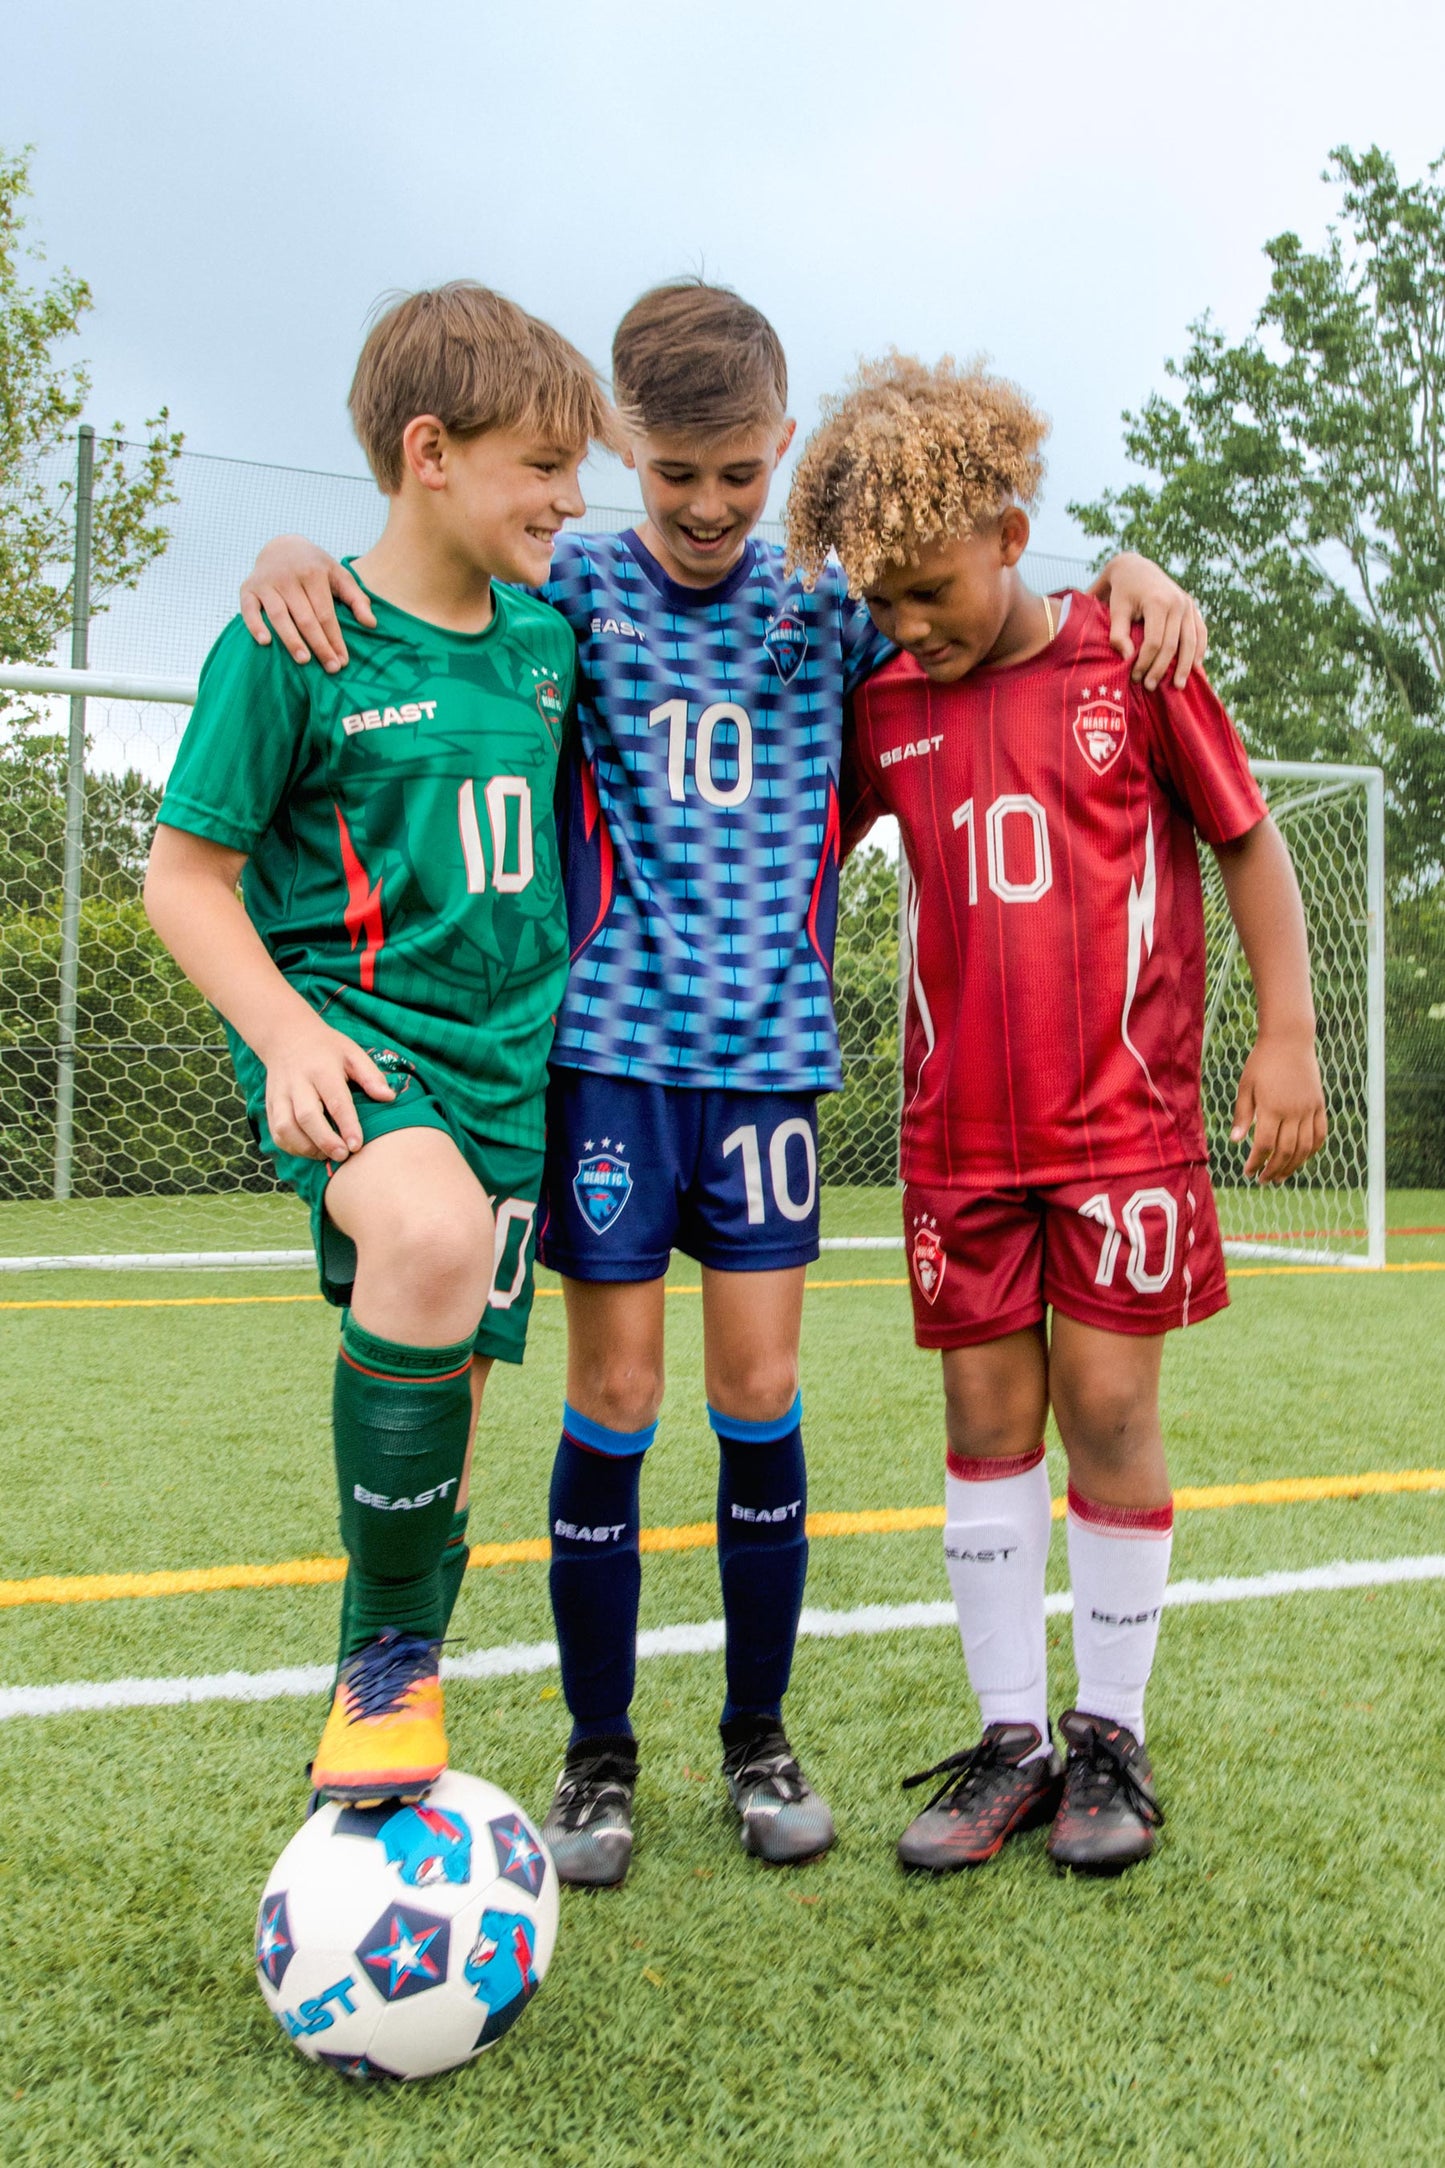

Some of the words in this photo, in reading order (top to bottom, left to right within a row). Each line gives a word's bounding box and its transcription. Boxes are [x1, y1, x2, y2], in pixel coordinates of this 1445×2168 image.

[590, 617, 646, 642] EAST
[341, 700, 438, 736] BEAST
[648, 698, 753, 808] 10
[879, 734, 944, 769] BEAST
[457, 776, 535, 894] 10
[951, 793, 1053, 906] 10
[721, 1117, 817, 1226] 10
[488, 1195, 537, 1310] 0
[1077, 1186, 1178, 1295] 10
[353, 1477, 459, 1511] BEAST
[731, 1499, 802, 1523] BEAST
[554, 1518, 627, 1543] BEAST
[944, 1546, 1018, 1563] EAST
[276, 1975, 357, 2038] AST
